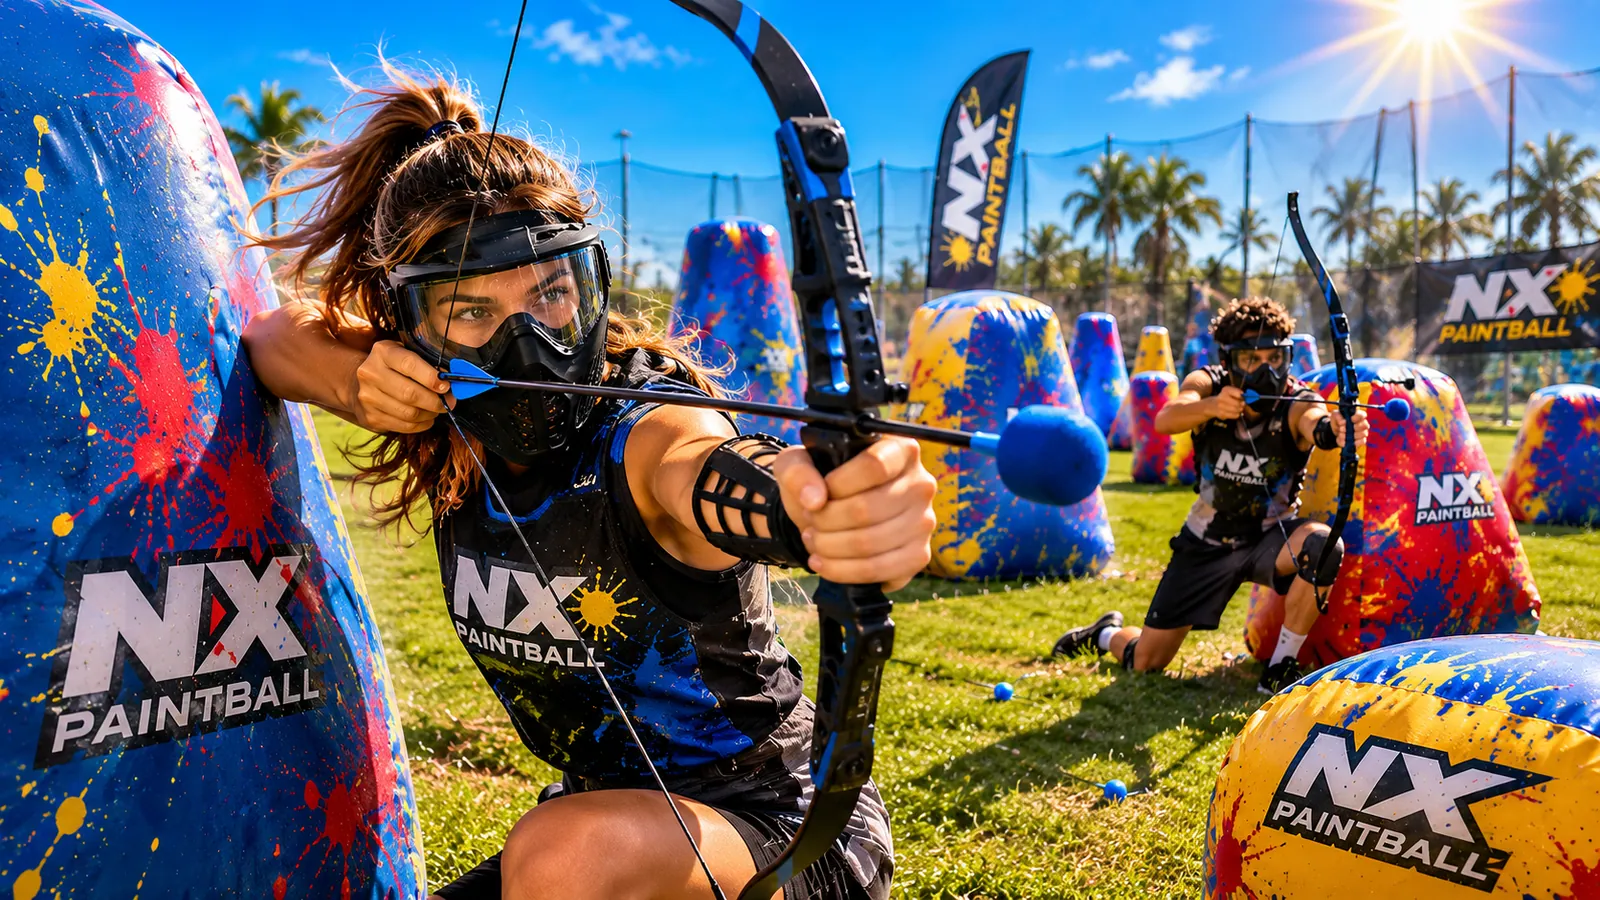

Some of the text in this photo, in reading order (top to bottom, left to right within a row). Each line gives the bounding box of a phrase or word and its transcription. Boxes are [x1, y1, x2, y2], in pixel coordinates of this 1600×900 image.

[941, 103, 998, 242] NX
[977, 103, 1016, 267] PAINTBALL
[1438, 317, 1572, 344] PAINTBALL
[1444, 263, 1569, 322] NX
[1215, 449, 1269, 478] NX
[1417, 472, 1486, 510] NX
[1416, 505, 1495, 524] PAINTBALL
[62, 555, 308, 698] NX
[453, 555, 588, 641] NX
[455, 620, 605, 668] PAINTBALL
[51, 669, 320, 753] PAINTBALL
[1283, 732, 1517, 843] NX
[1271, 800, 1487, 881] PAINTBALL
